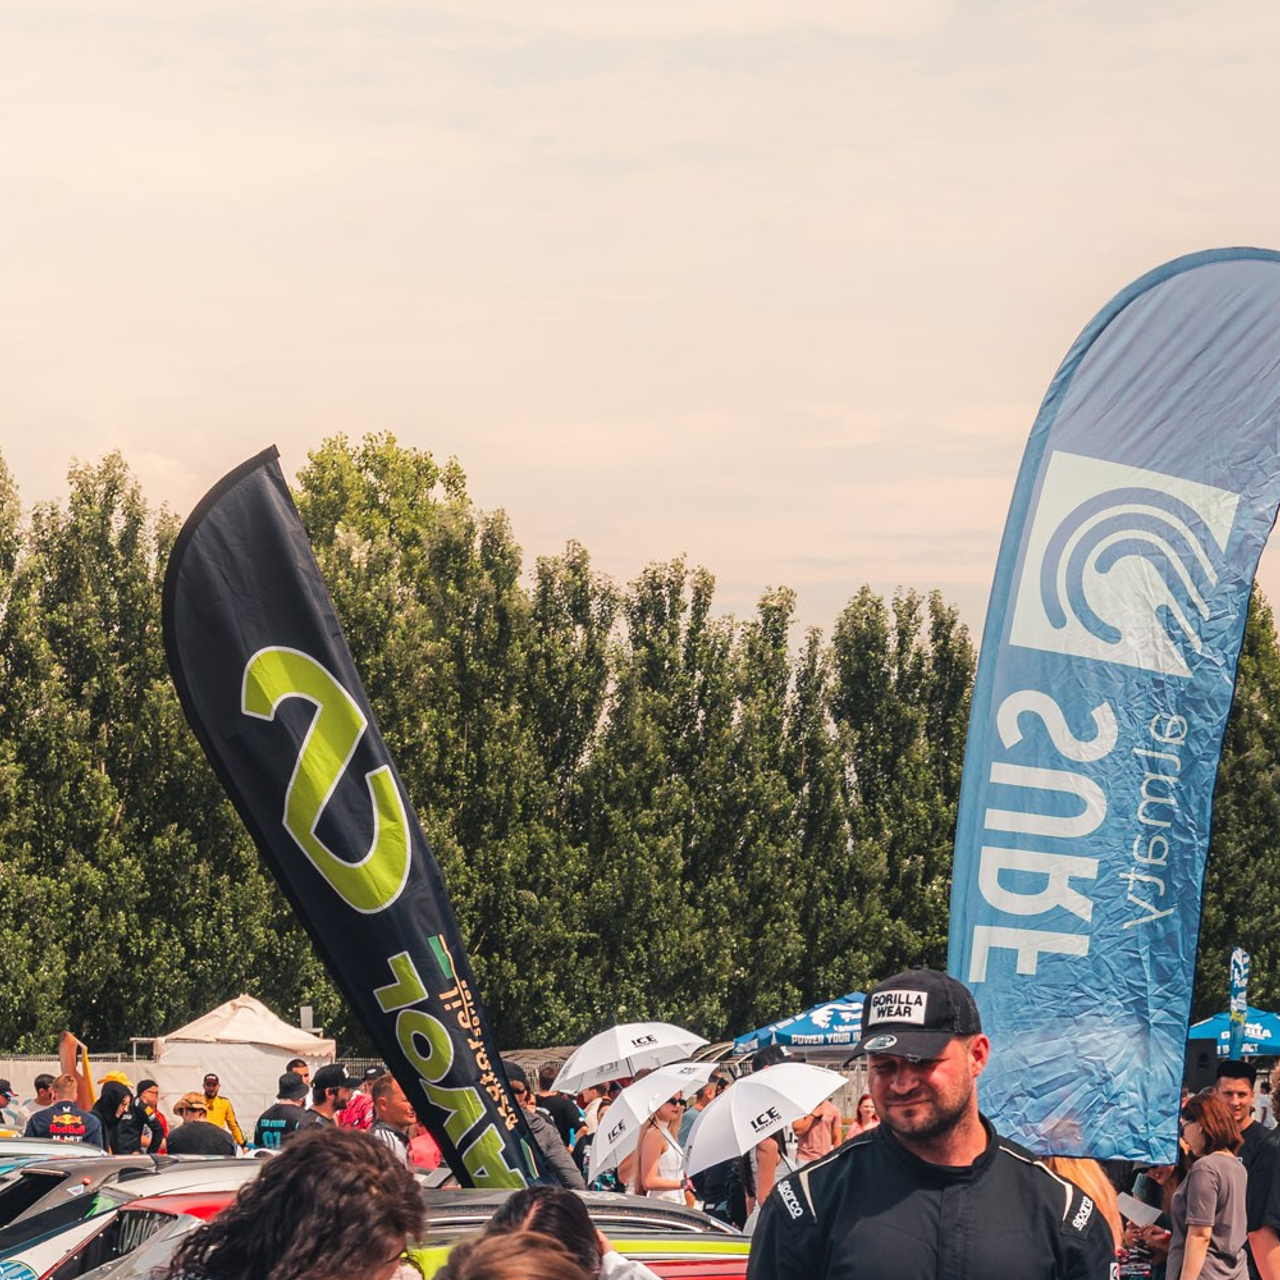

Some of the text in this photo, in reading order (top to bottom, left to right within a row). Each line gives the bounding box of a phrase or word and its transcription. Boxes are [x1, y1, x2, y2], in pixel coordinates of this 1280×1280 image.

[872, 993, 924, 1008] GORILLA
[876, 1005, 912, 1019] WEAR
[631, 1034, 657, 1047] ICE
[791, 1033, 825, 1046] POWER
[826, 1032, 851, 1045] YOUR
[750, 1106, 780, 1130] ICE
[607, 1118, 627, 1141] ICE
[777, 1180, 804, 1220] sparco
